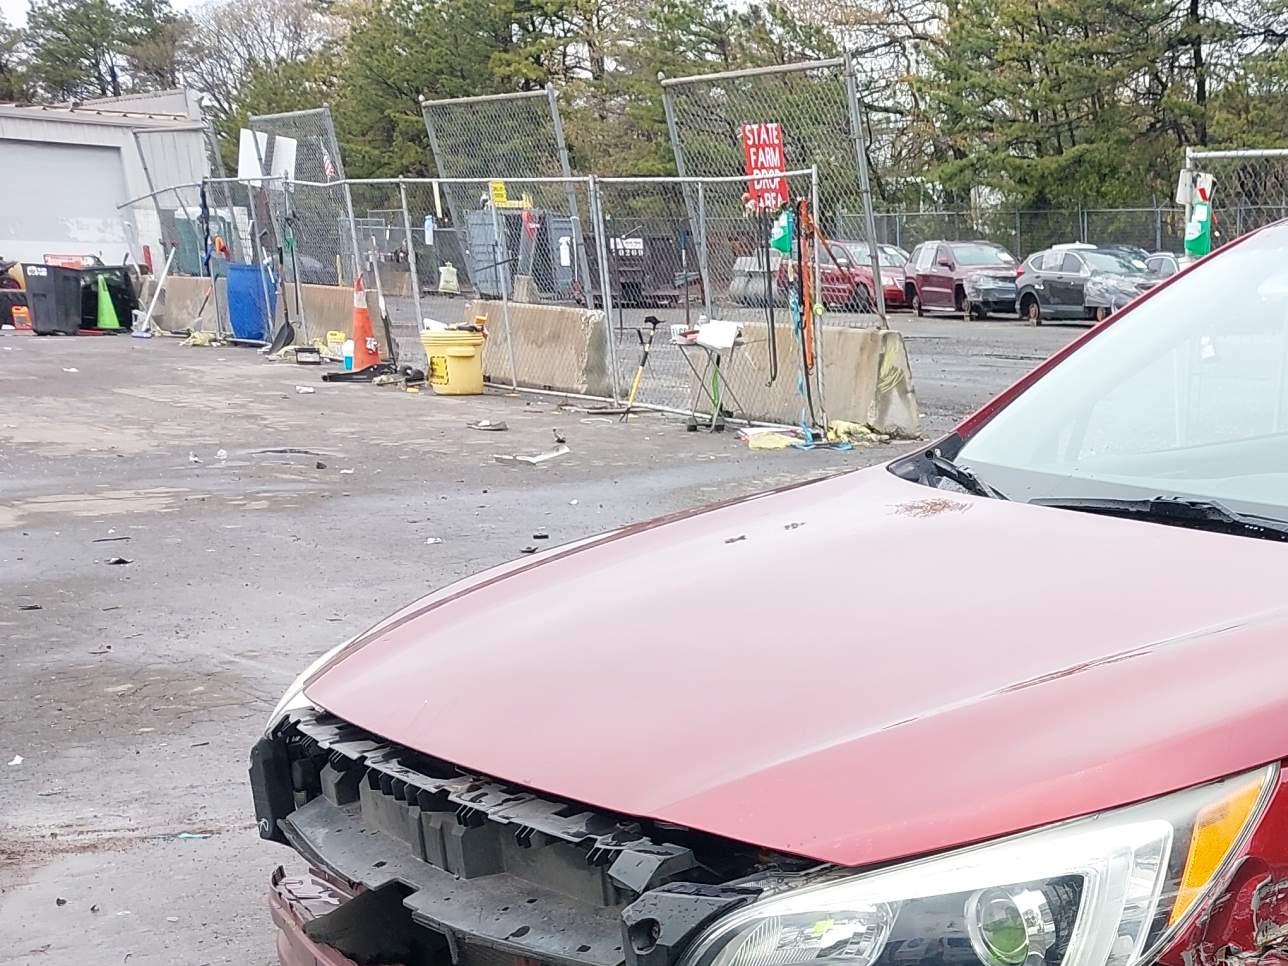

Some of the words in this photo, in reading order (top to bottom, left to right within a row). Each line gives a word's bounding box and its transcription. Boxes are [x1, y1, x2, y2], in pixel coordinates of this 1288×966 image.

[745, 123, 780, 145] STATE
[750, 147, 781, 168] FARM
[752, 168, 781, 190] DROP
